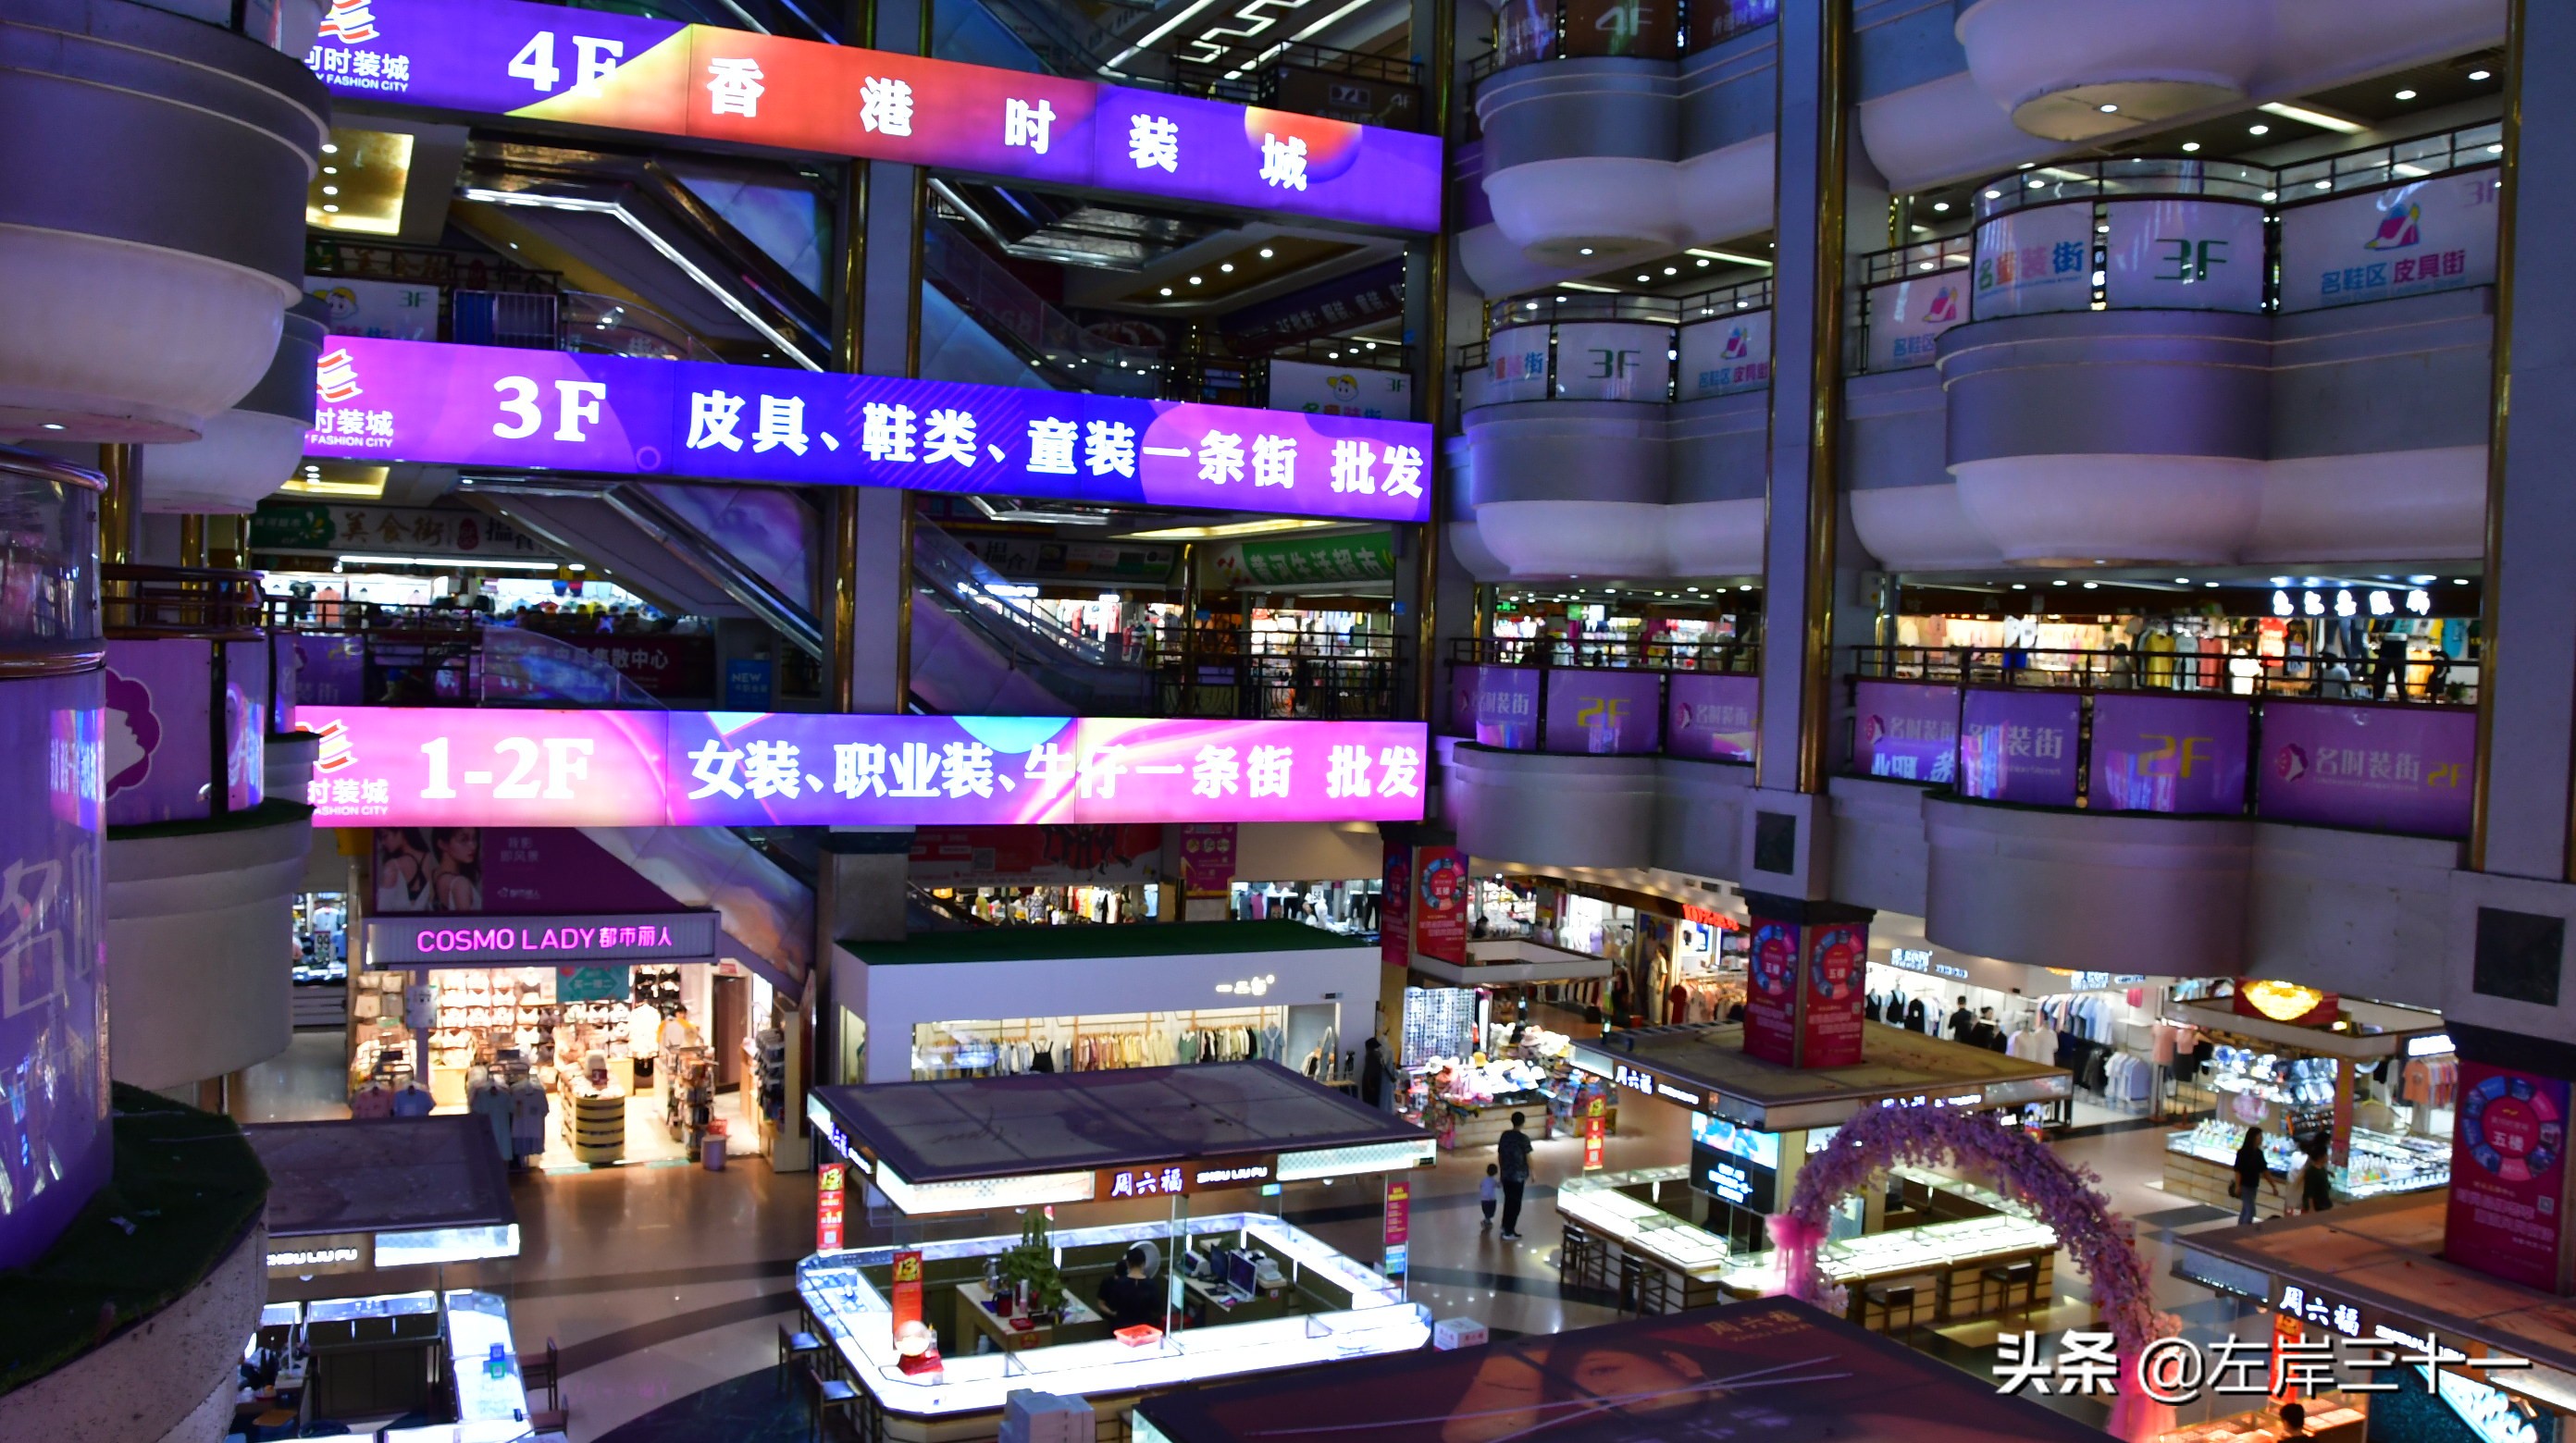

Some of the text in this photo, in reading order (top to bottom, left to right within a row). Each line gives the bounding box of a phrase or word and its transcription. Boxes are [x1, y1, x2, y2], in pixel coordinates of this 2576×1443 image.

[327, 74, 408, 92] FASHION CITY
[507, 31, 1307, 191] 4F 香港时装城
[2154, 239, 2228, 282] 3F
[2322, 262, 2387, 295] 名鞋区
[2394, 250, 2466, 284] 皮具街
[1587, 349, 1641, 379] 3F
[311, 434, 392, 448] FASHION CITY
[493, 376, 1424, 499] 3F 皮具、鞋类、童装一条街 批发
[342, 512, 444, 547] 美食街
[421, 736, 1419, 800] 1-2F 女装、职业装、牛仔一条街 批发
[2137, 734, 2214, 779] 2F
[2315, 746, 2421, 783] 名时装街
[313, 806, 389, 816] ASHION CITY
[416, 926, 673, 953] COSMO LADY 都市丽人
[1111, 1168, 1183, 1197] 周六福
[2279, 1286, 2360, 1337] 周六福
